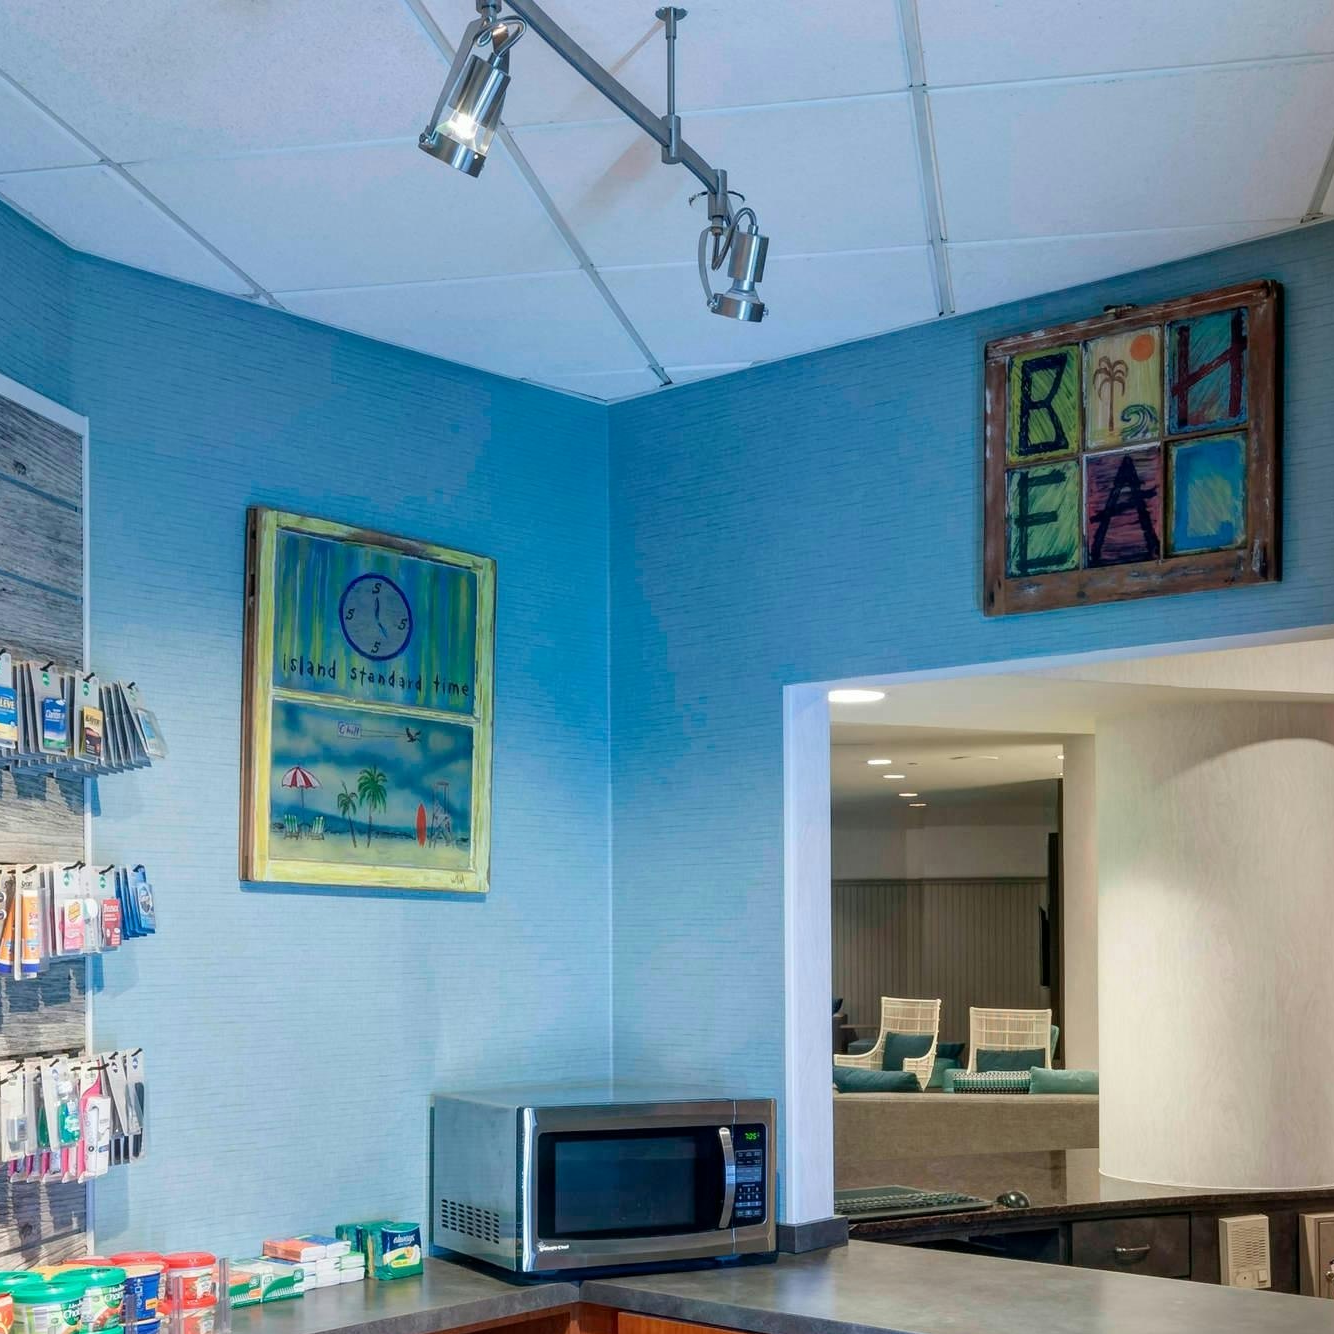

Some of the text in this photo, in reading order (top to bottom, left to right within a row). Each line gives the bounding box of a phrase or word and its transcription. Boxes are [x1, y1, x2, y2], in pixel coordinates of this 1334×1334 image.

[350, 666, 423, 693] standard
[433, 675, 470, 697] time
[339, 724, 362, 738] Chill
